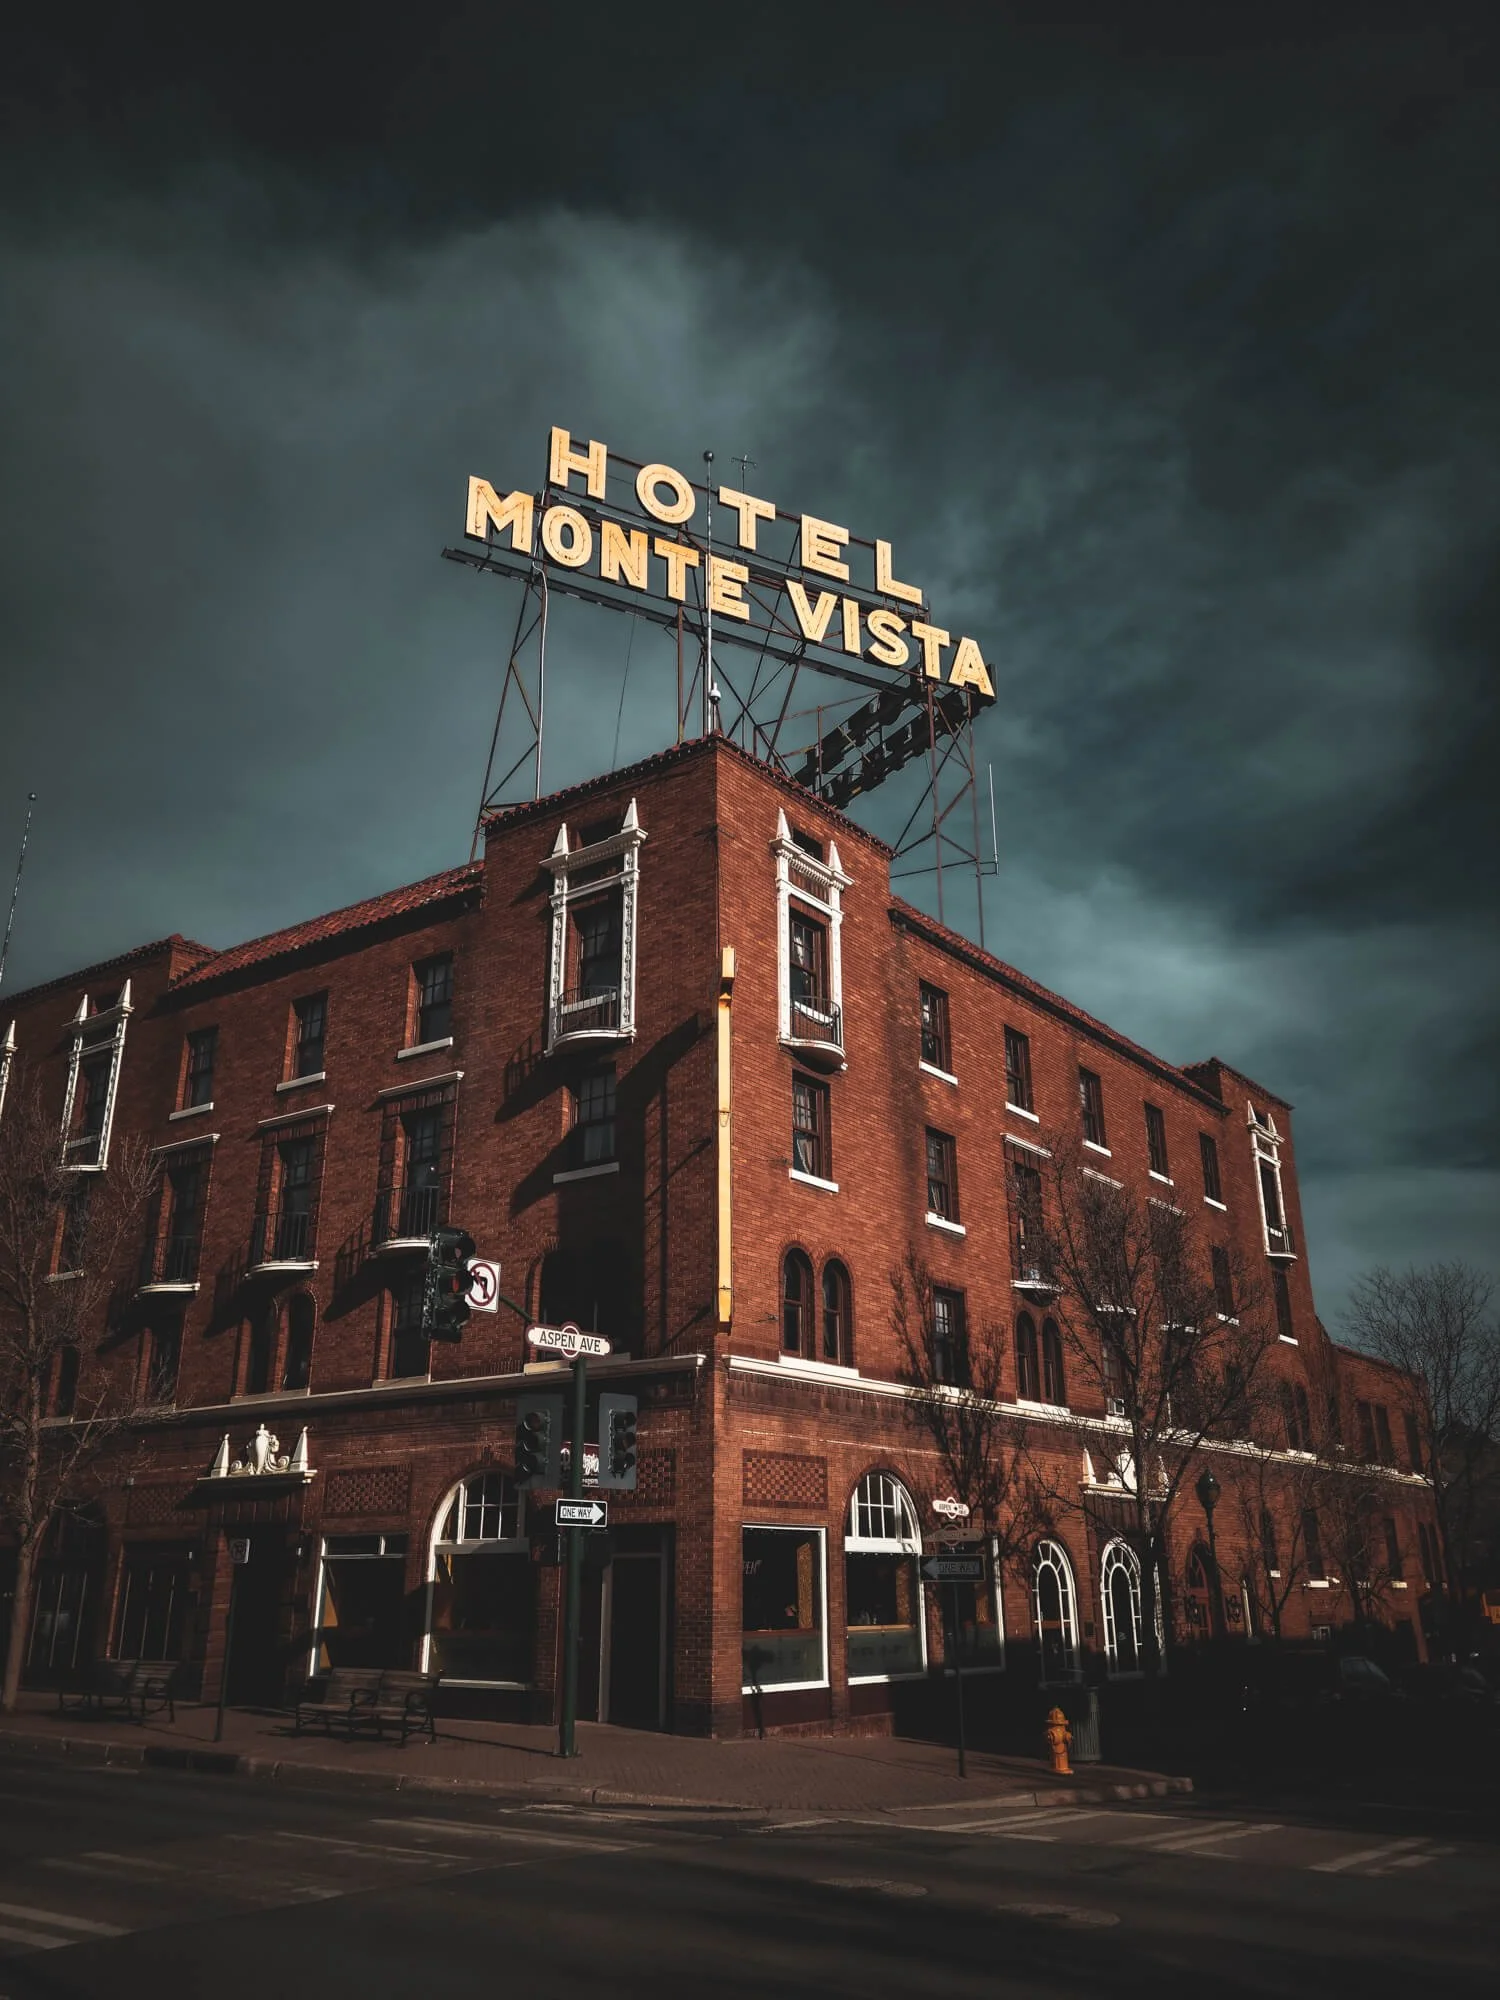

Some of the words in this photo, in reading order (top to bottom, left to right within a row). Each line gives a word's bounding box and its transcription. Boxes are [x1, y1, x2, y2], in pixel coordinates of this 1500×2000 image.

[549, 425, 922, 605] HOTEL
[464, 475, 750, 621] MONTE
[786, 579, 995, 697] VISTA
[539, 1330, 575, 1348] ASPEN
[580, 1337, 601, 1352] AVE
[562, 1507, 576, 1518] ONE
[578, 1508, 592, 1518] WAY
[938, 1562, 957, 1574] ONE
[959, 1563, 978, 1574] WAY
